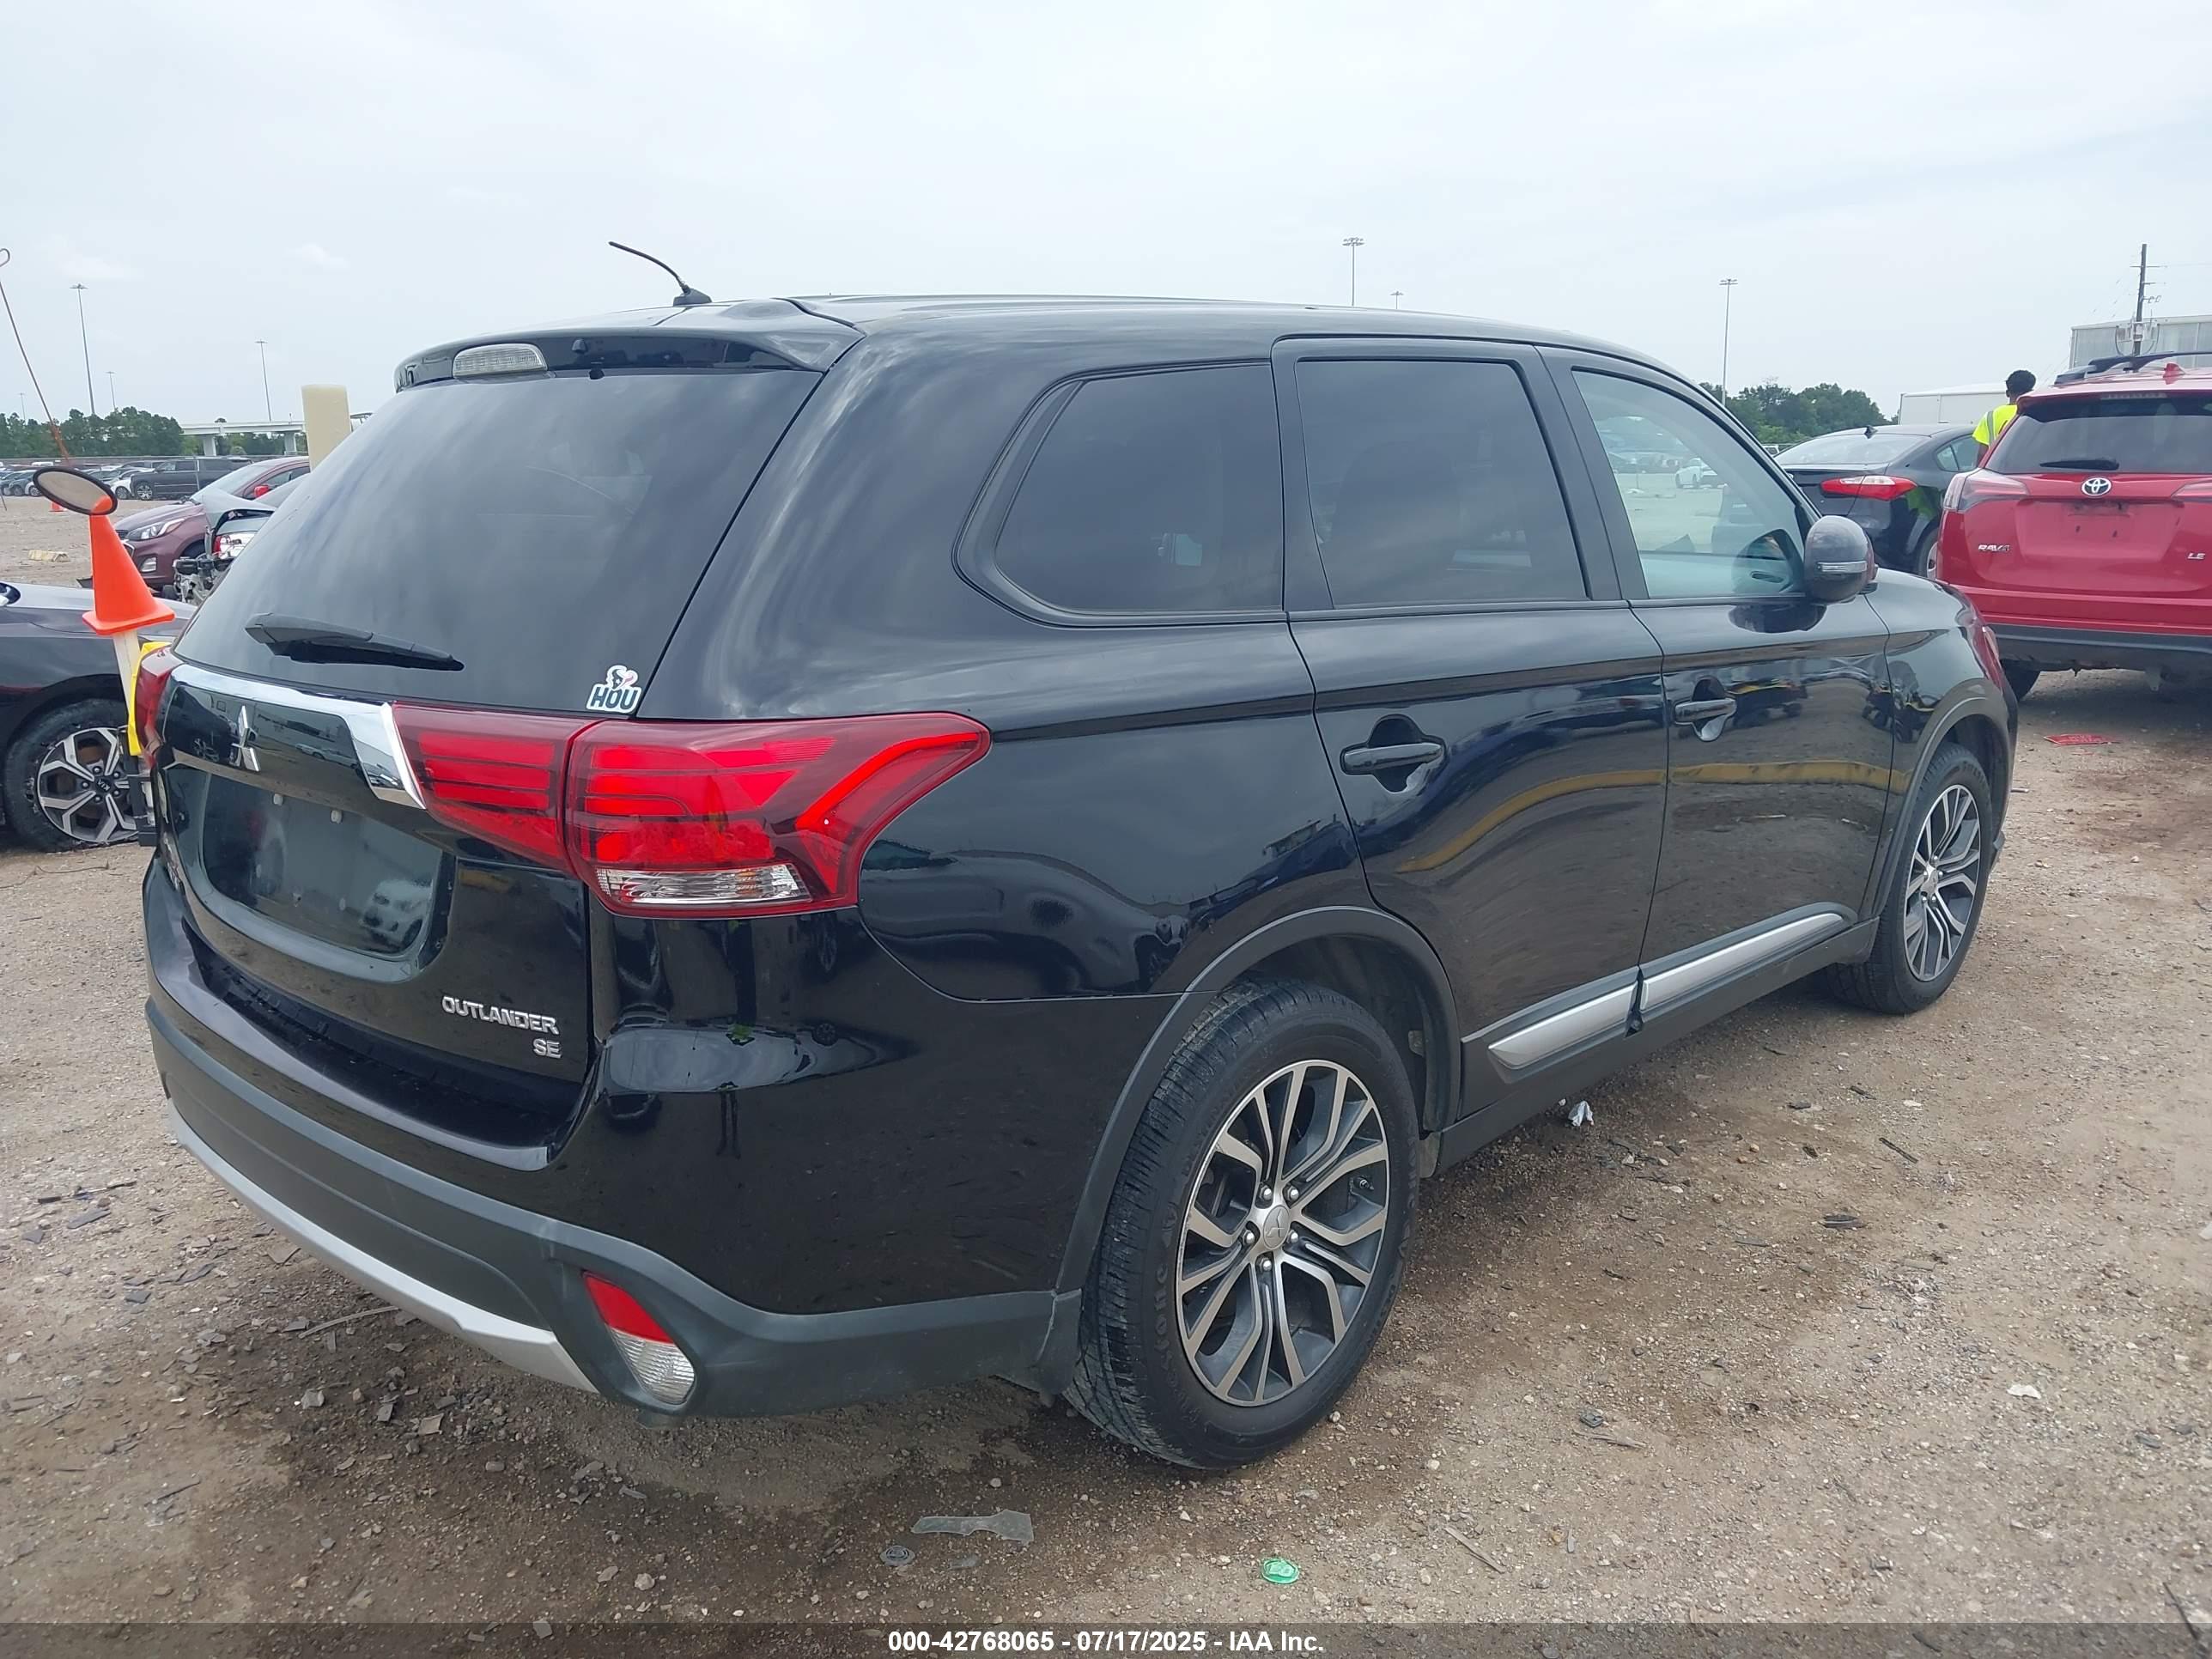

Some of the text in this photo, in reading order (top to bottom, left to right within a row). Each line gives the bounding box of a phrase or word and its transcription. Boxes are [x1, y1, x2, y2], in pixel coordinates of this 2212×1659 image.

[590, 686, 639, 710] HOU
[441, 996, 559, 1035] OUTLANDER
[532, 1038, 562, 1059] SE
